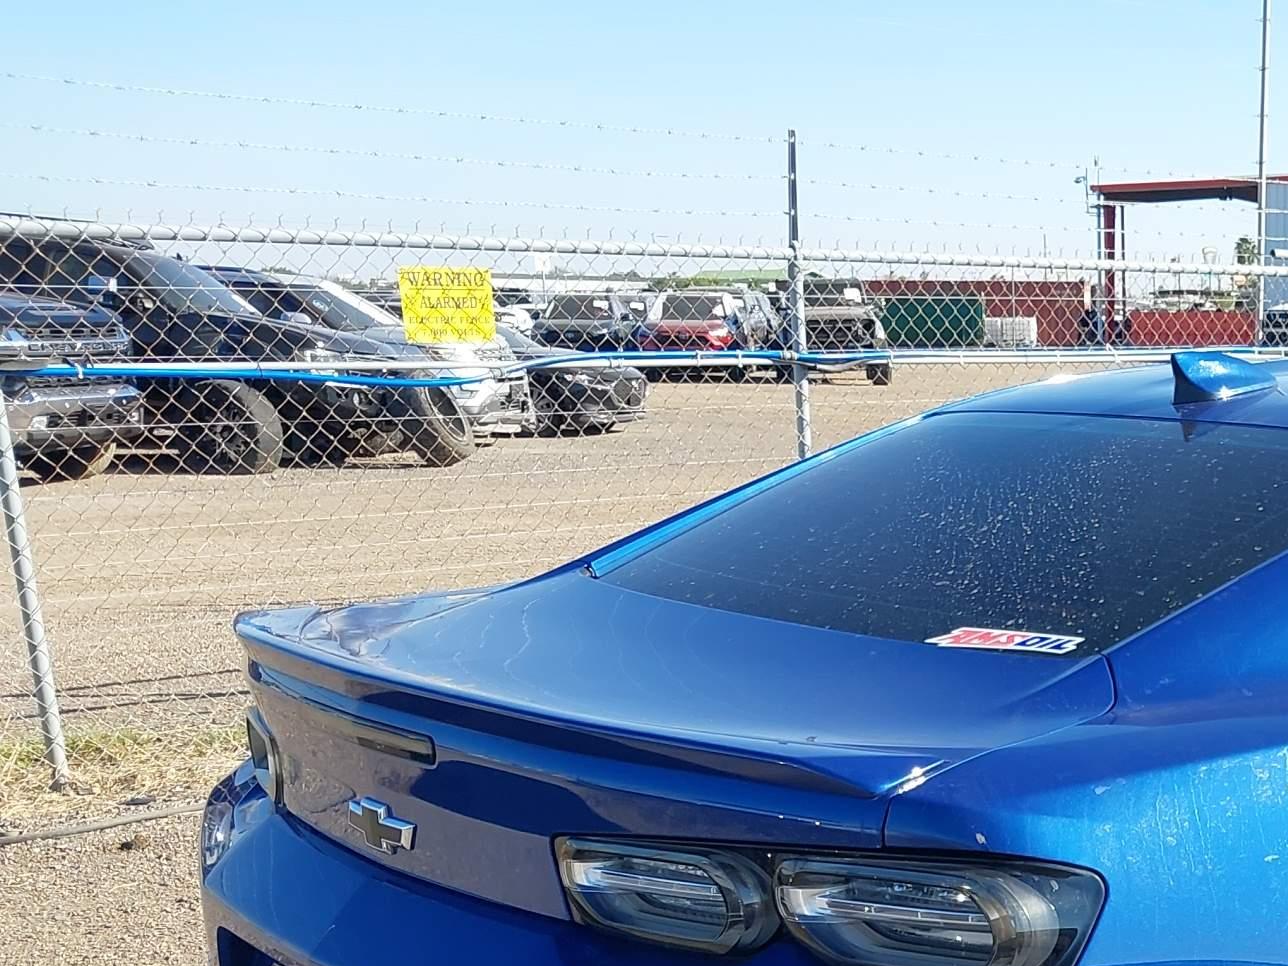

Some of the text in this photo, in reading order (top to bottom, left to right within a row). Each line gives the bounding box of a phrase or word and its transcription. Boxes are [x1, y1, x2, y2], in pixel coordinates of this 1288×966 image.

[404, 271, 485, 288] WARNING
[420, 296, 478, 309] ALARMED
[408, 316, 490, 325] ELECTRIC FENCE
[936, 629, 1076, 651] AMSOIL
